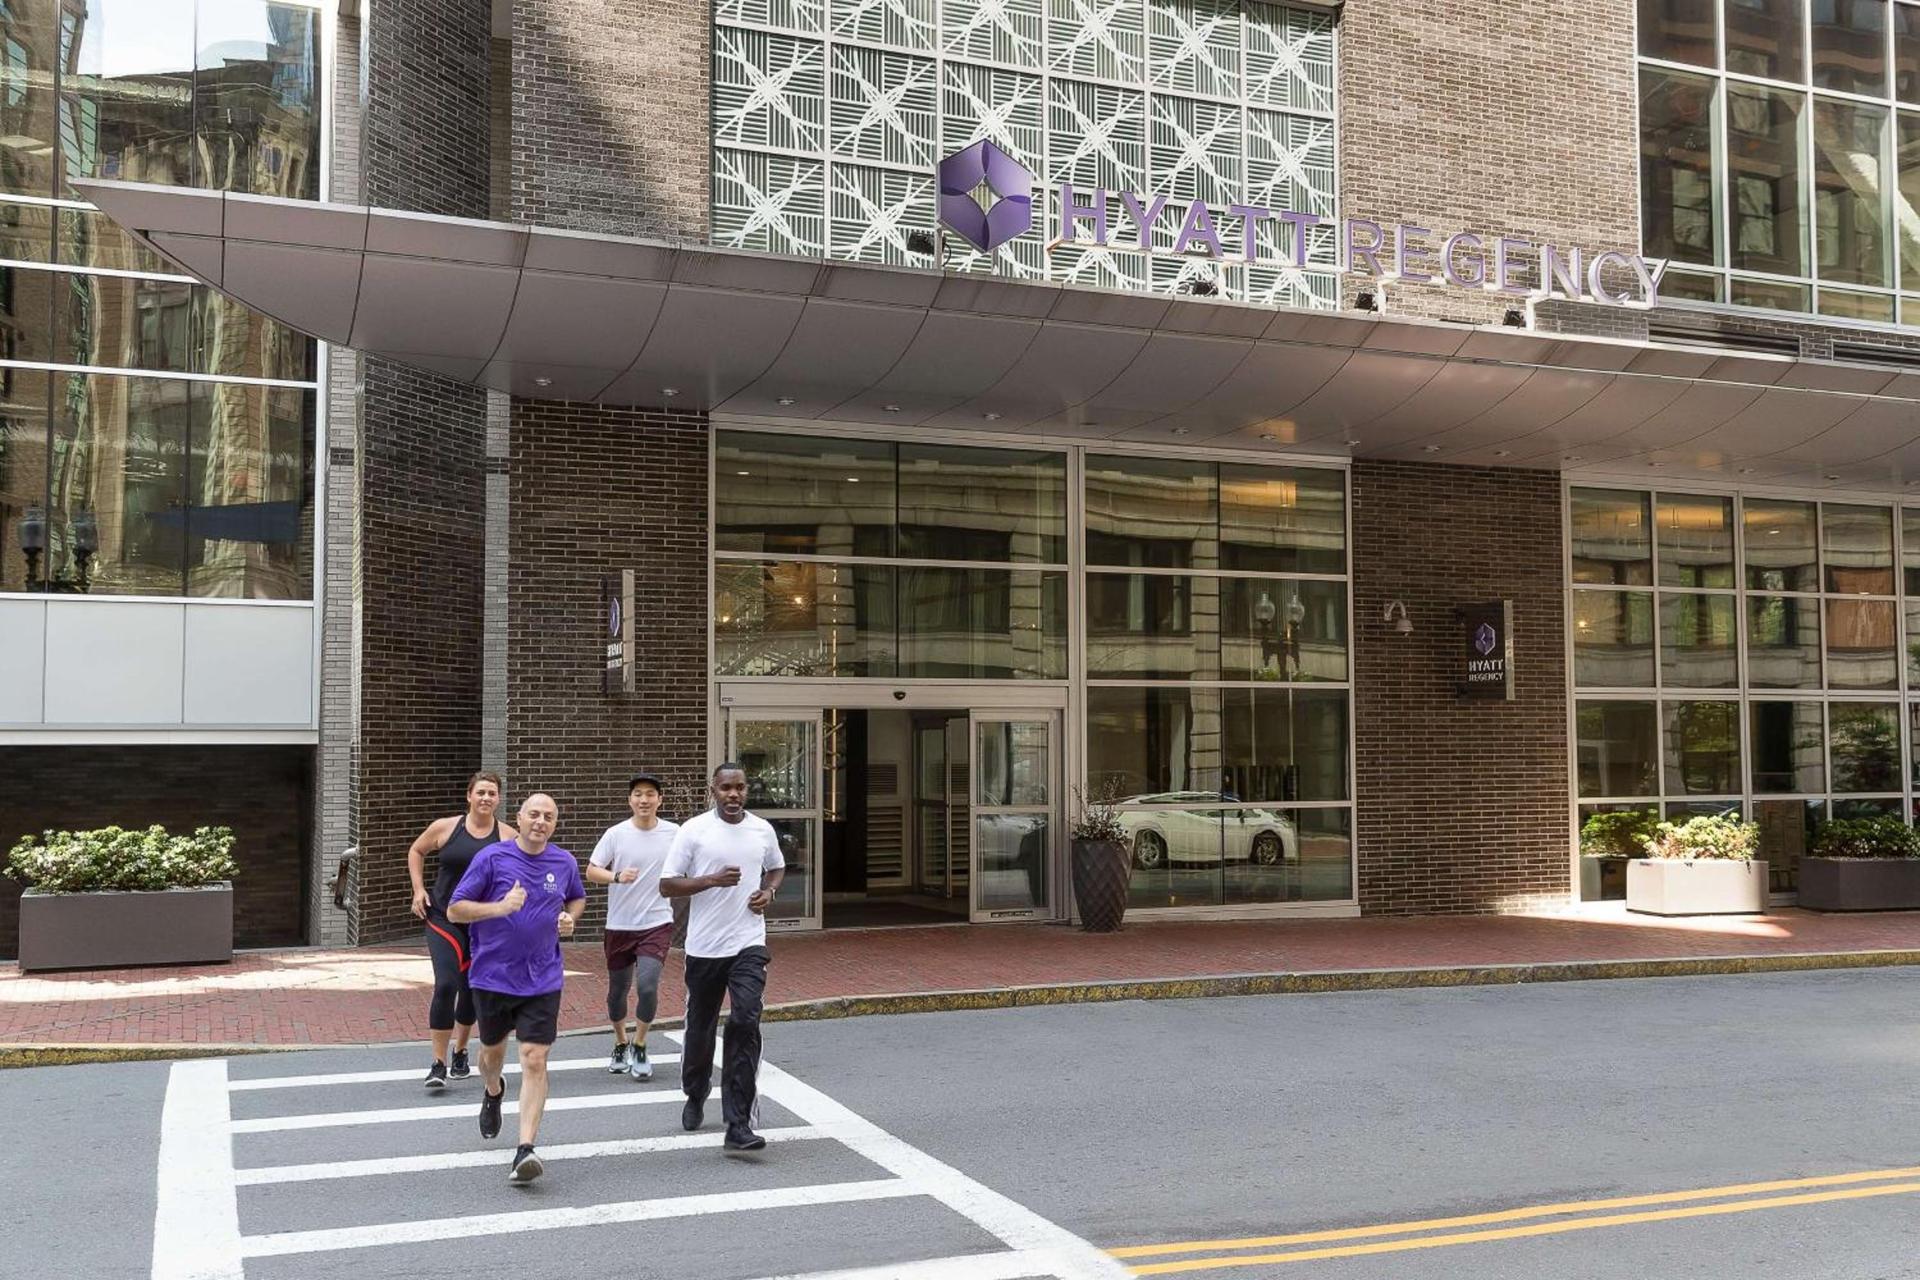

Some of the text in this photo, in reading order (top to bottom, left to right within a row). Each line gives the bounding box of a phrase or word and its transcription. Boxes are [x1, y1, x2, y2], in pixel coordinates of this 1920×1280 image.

[1060, 183, 1669, 307] HYATT REGENCY
[1469, 659, 1503, 671] HYATT
